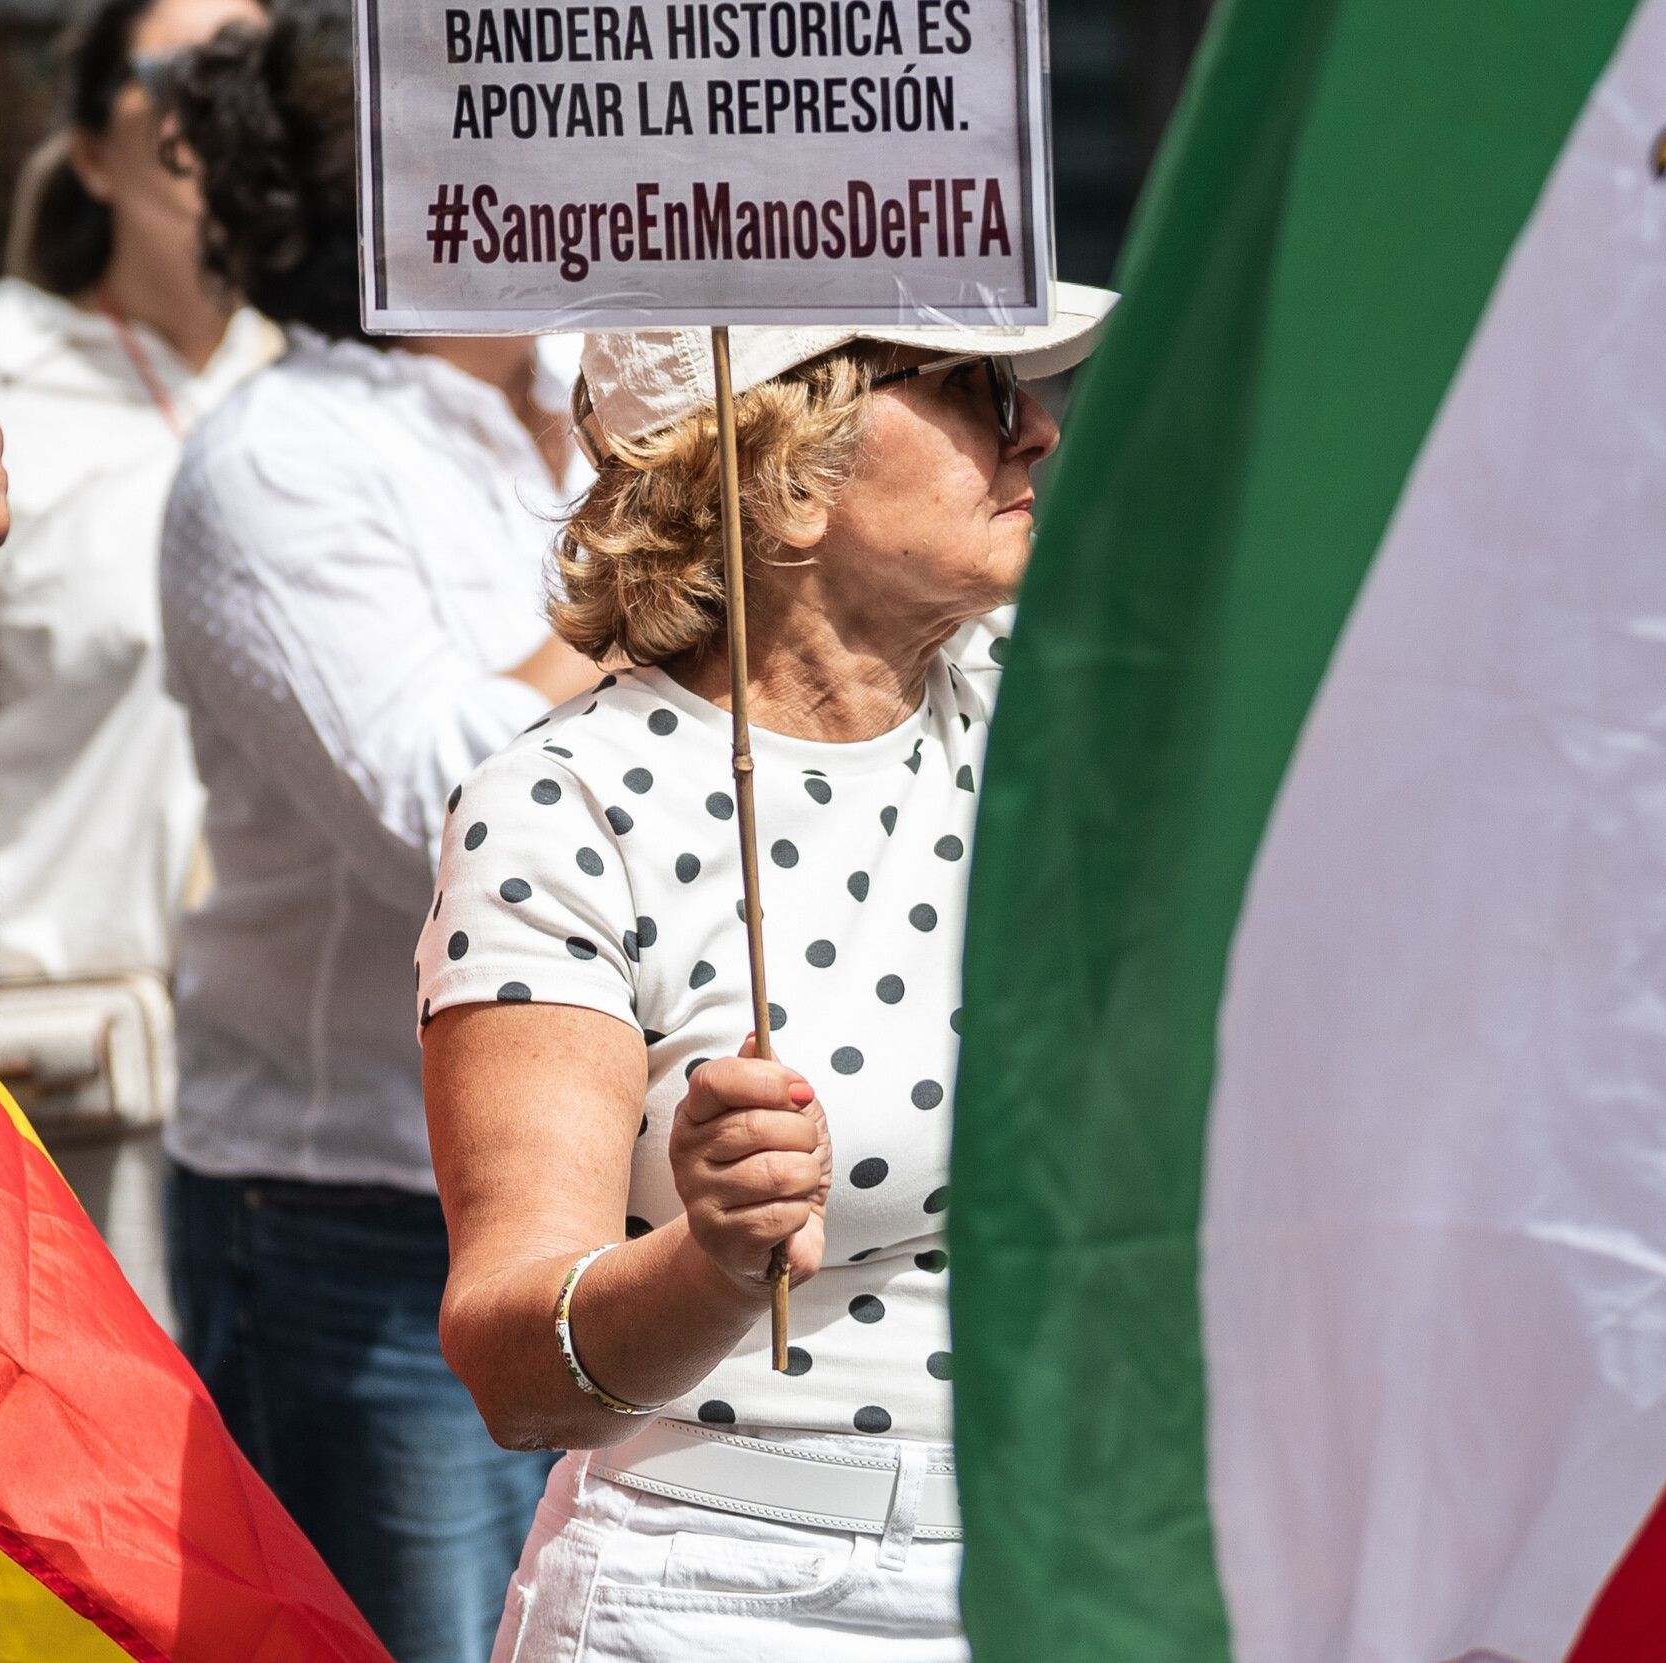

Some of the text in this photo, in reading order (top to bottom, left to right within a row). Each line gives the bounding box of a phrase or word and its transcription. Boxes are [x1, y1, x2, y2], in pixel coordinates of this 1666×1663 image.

[446, 5, 653, 63] BANDERA
[452, 64, 969, 139] APOYAR LA REPRESIÓN.
[427, 177, 1011, 282] #SangreEnManosDeFIFA
